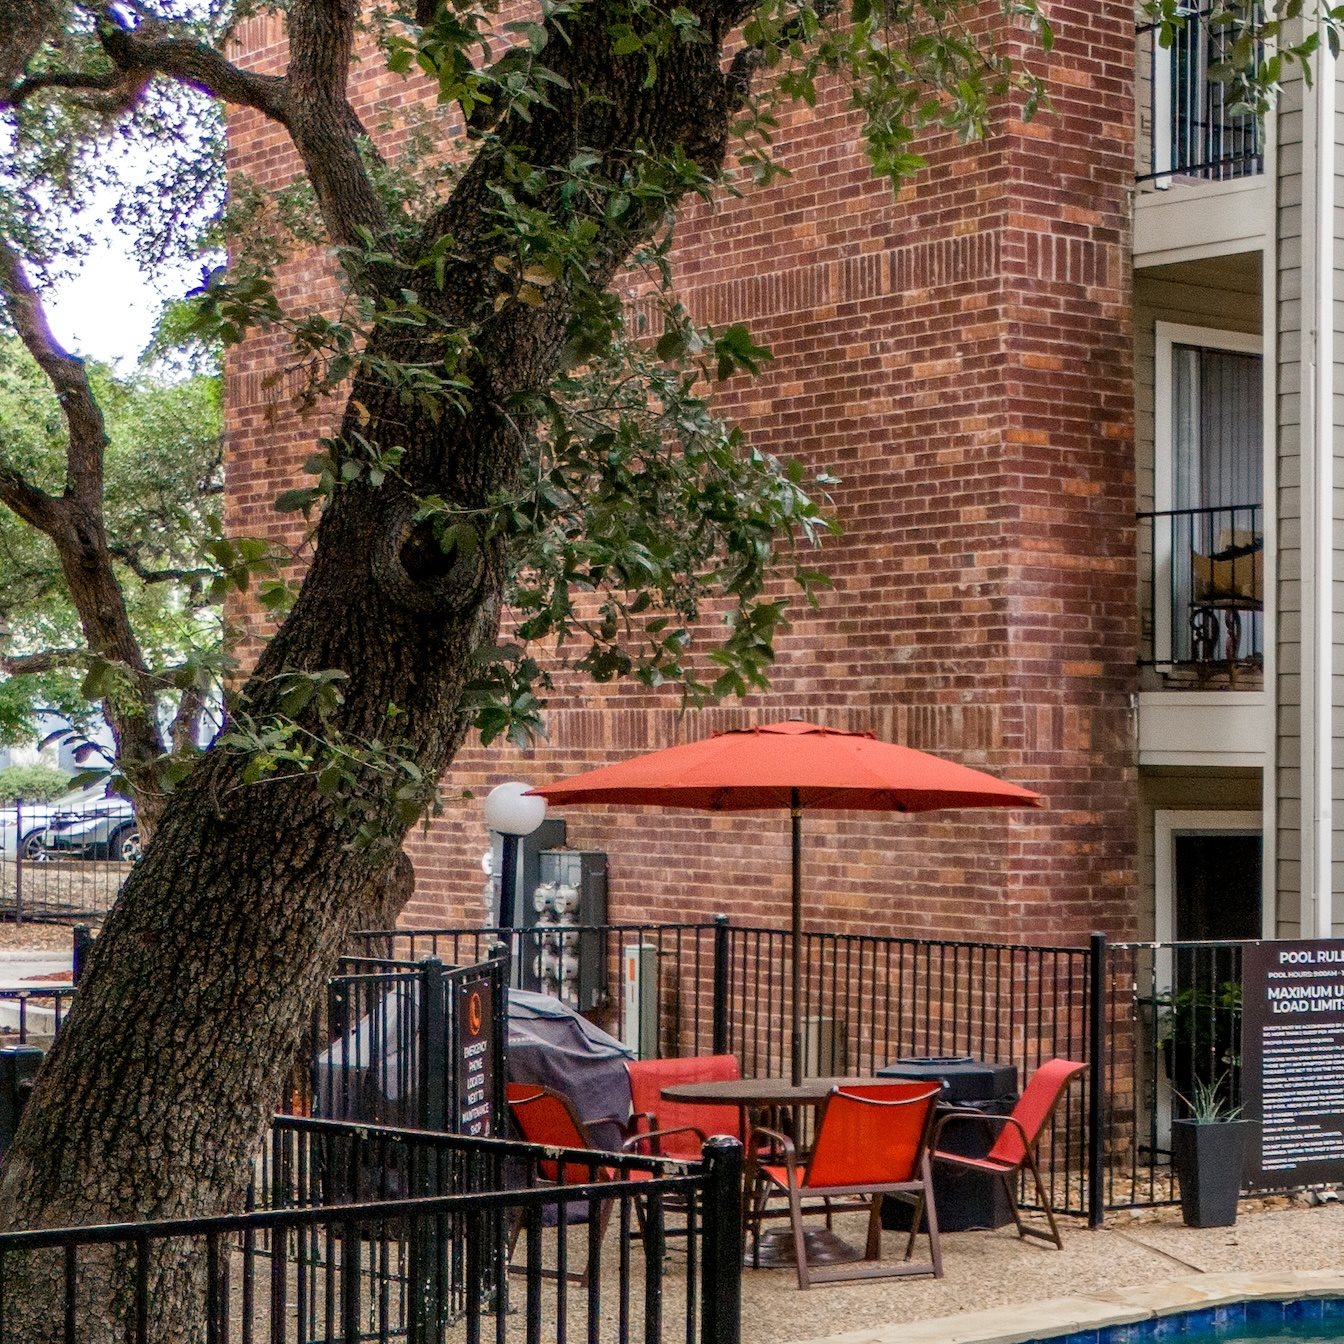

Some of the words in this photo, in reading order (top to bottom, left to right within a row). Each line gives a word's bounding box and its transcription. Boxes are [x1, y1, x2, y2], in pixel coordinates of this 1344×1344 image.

[1280, 952, 1316, 964] POOL
[1268, 986, 1332, 999] MAXIMUM
[1273, 1001, 1309, 1013] LOAD
